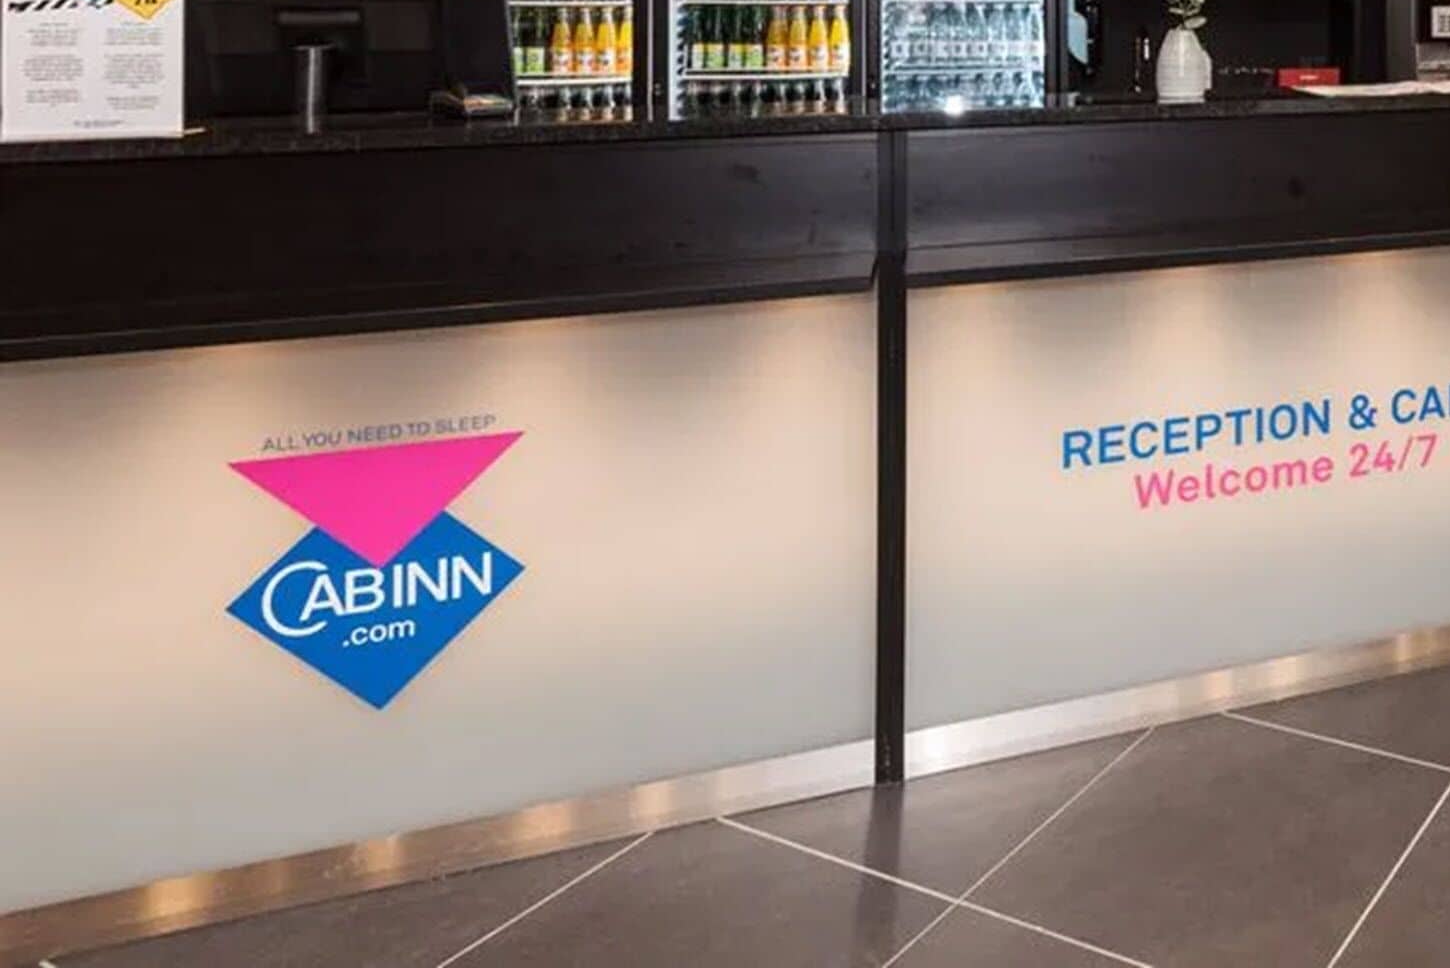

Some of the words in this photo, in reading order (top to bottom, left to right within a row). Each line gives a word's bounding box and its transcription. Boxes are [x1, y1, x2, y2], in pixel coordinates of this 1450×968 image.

[261, 436, 298, 453] ALL
[301, 430, 342, 448] YOU
[347, 423, 402, 444] NEED
[407, 420, 432, 438] TO
[434, 413, 496, 435] SLEEP
[1062, 398, 1331, 469] RECEPTION
[1348, 394, 1378, 431] &
[1134, 454, 1334, 509] Welcome
[1348, 433, 1438, 478] 24/7
[261, 551, 492, 638] CABINN
[342, 619, 416, 648] .com
